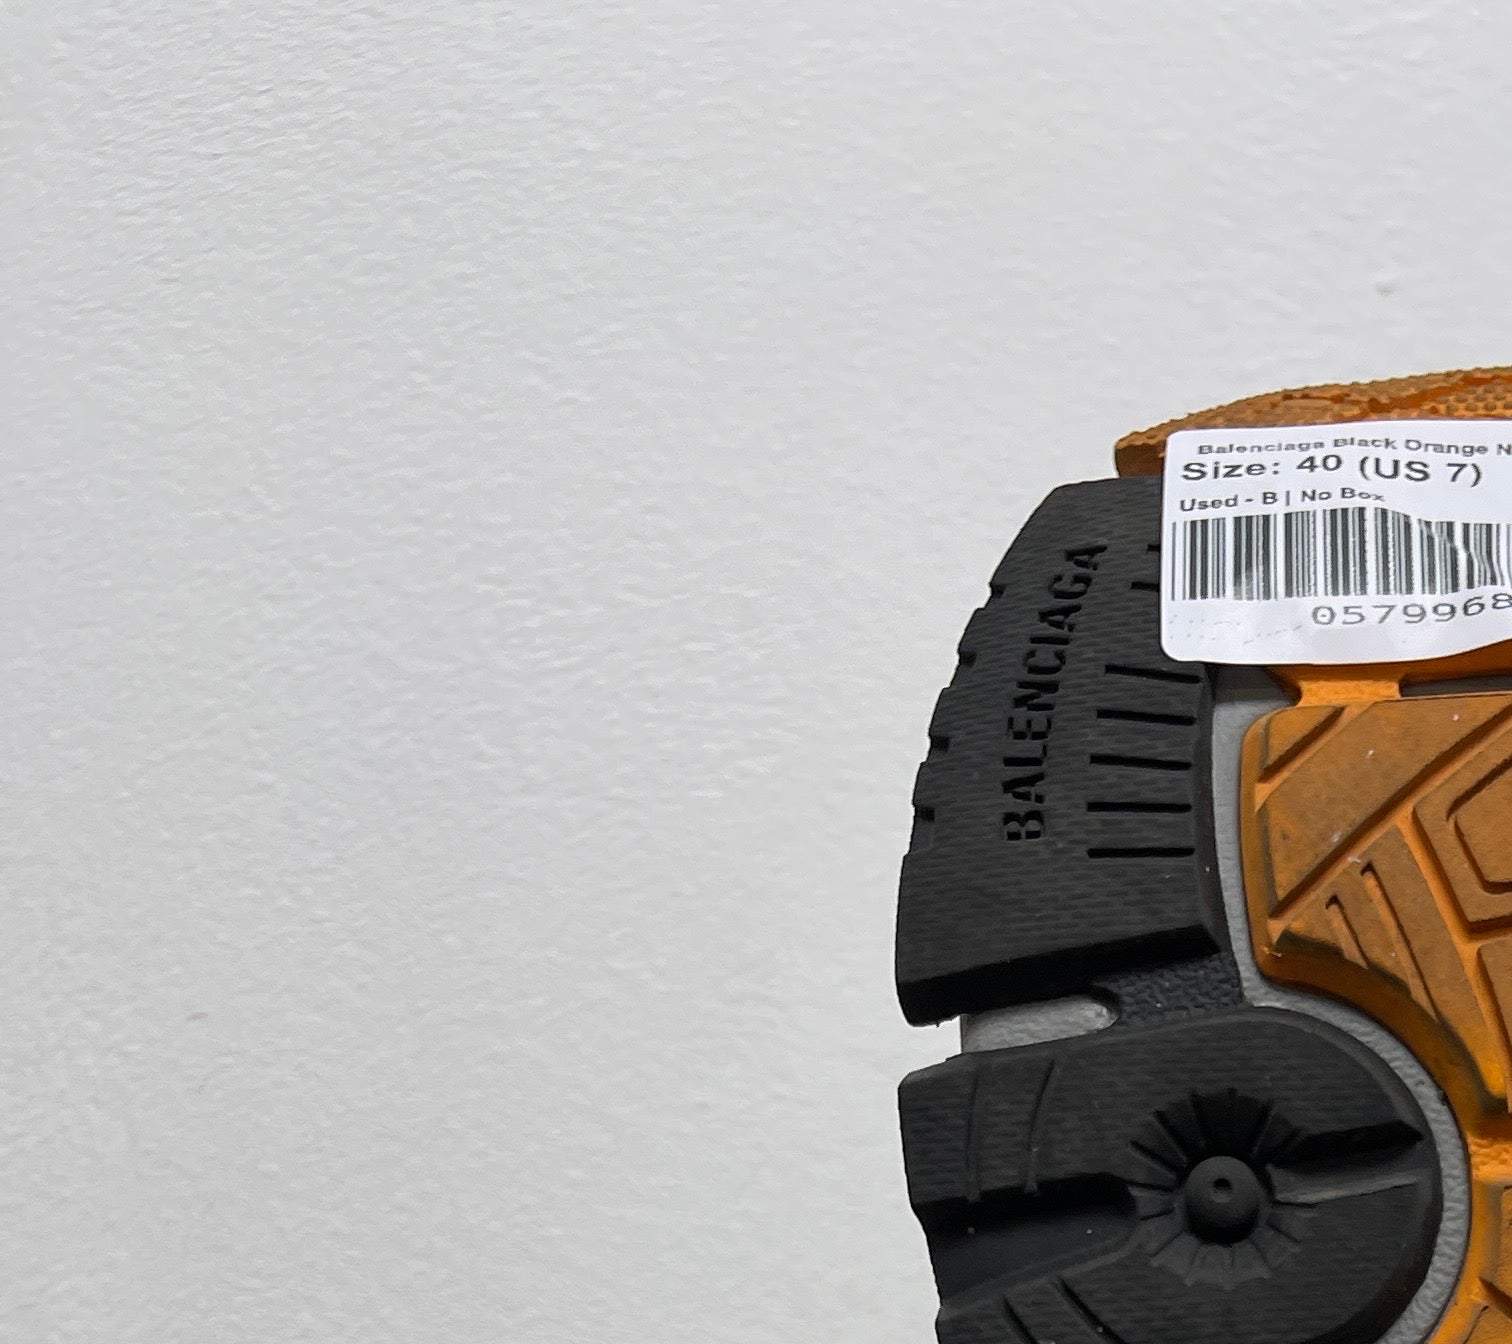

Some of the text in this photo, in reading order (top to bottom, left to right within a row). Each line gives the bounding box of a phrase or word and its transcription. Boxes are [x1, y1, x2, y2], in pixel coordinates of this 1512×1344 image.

[1197, 440, 1325, 455] Balenciaga
[1333, 437, 1398, 450] Black
[1404, 438, 1489, 456] Orange
[1182, 454, 1482, 488] Size: 40 (US 7)
[1180, 494, 1238, 512] Used
[1262, 491, 1277, 505] B
[1301, 489, 1332, 501] No
[1340, 487, 1386, 502] Box
[1003, 544, 1108, 841] BALENCIAGA
